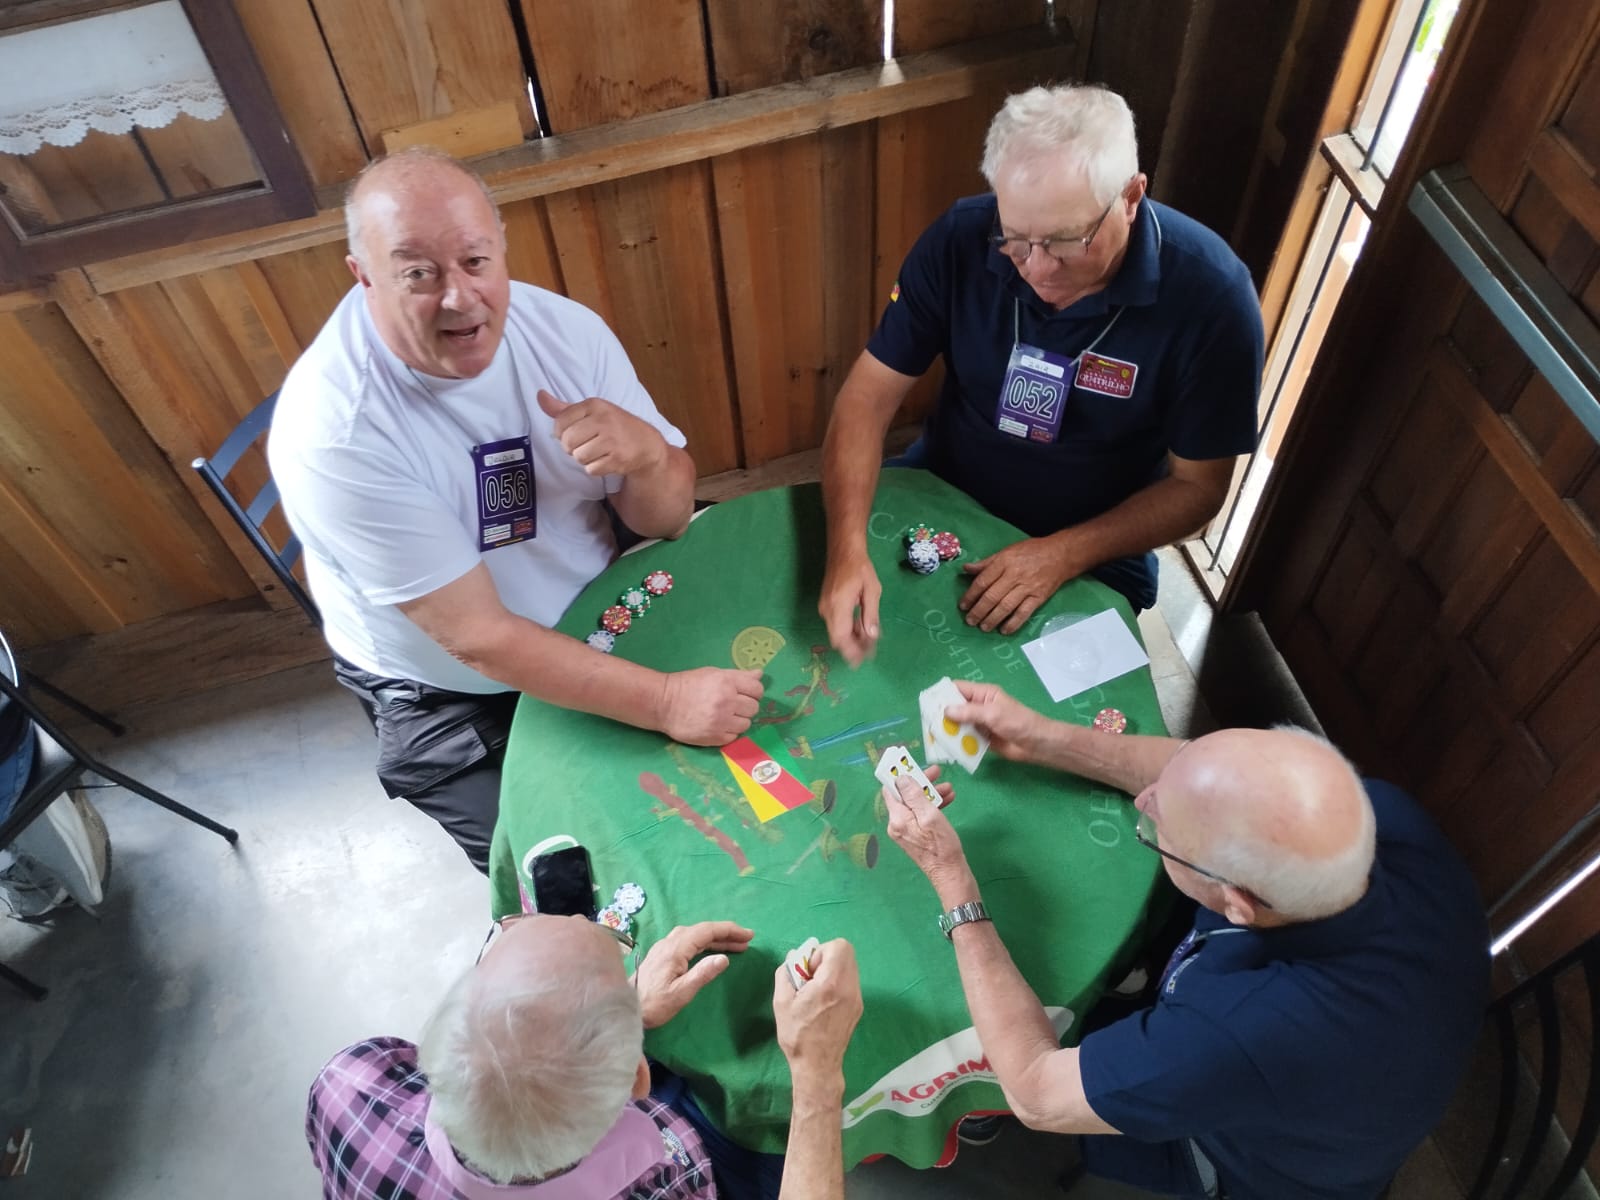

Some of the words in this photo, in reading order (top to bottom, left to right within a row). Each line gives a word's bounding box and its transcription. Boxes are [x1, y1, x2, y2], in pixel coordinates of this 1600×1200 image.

[1008, 375, 1058, 419] 052
[485, 470, 528, 511] 056
[891, 1055, 994, 1104] AGRIM
